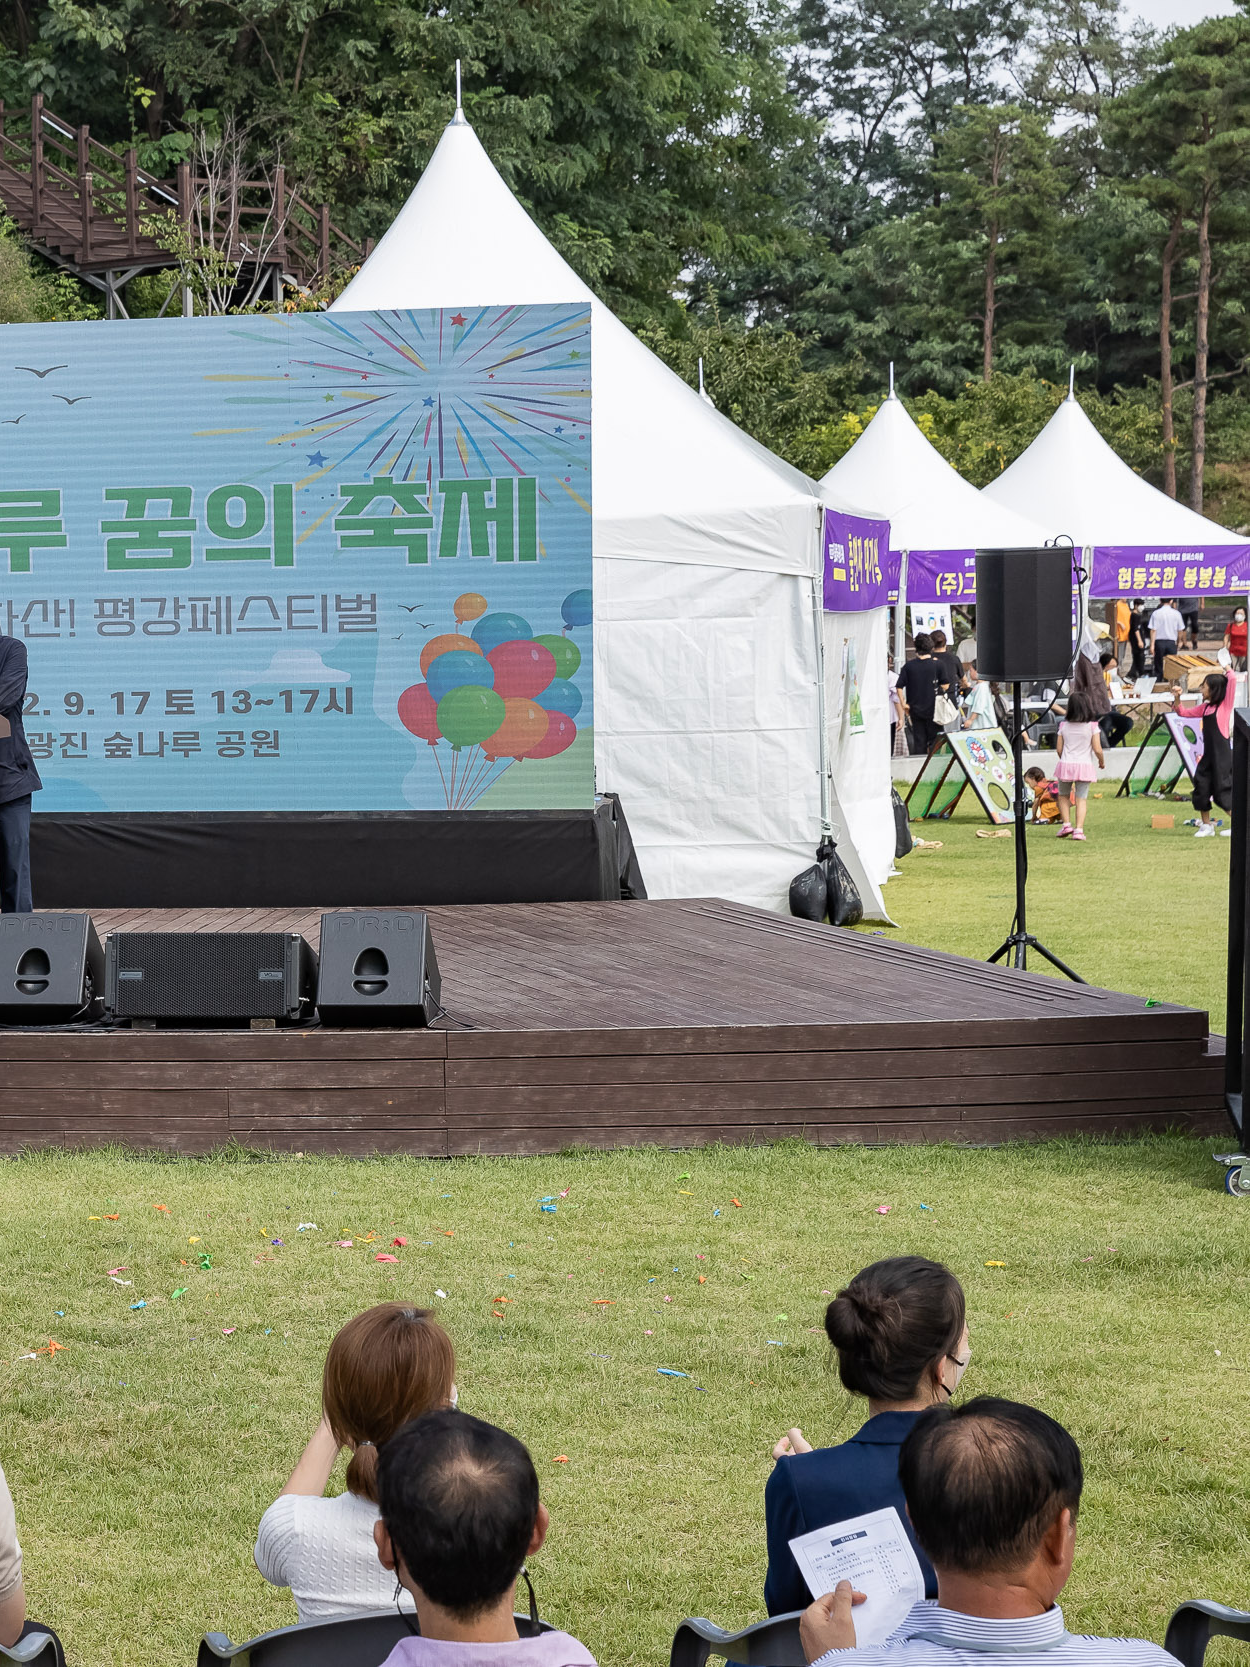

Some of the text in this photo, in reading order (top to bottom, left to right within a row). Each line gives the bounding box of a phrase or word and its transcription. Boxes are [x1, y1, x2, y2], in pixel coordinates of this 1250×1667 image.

[100, 483, 295, 572] 꿈의
[334, 476, 538, 565] 축제
[935, 572, 976, 597] (주)그
[1117, 566, 1177, 590] 협동조합
[93, 592, 378, 637] 평강페스티벌
[63, 691, 96, 716] 9.
[110, 691, 150, 715] 17
[164, 689, 196, 716] 토
[211, 686, 356, 715] 13~17시
[29, 728, 282, 760] 광진 숲나루 공원
